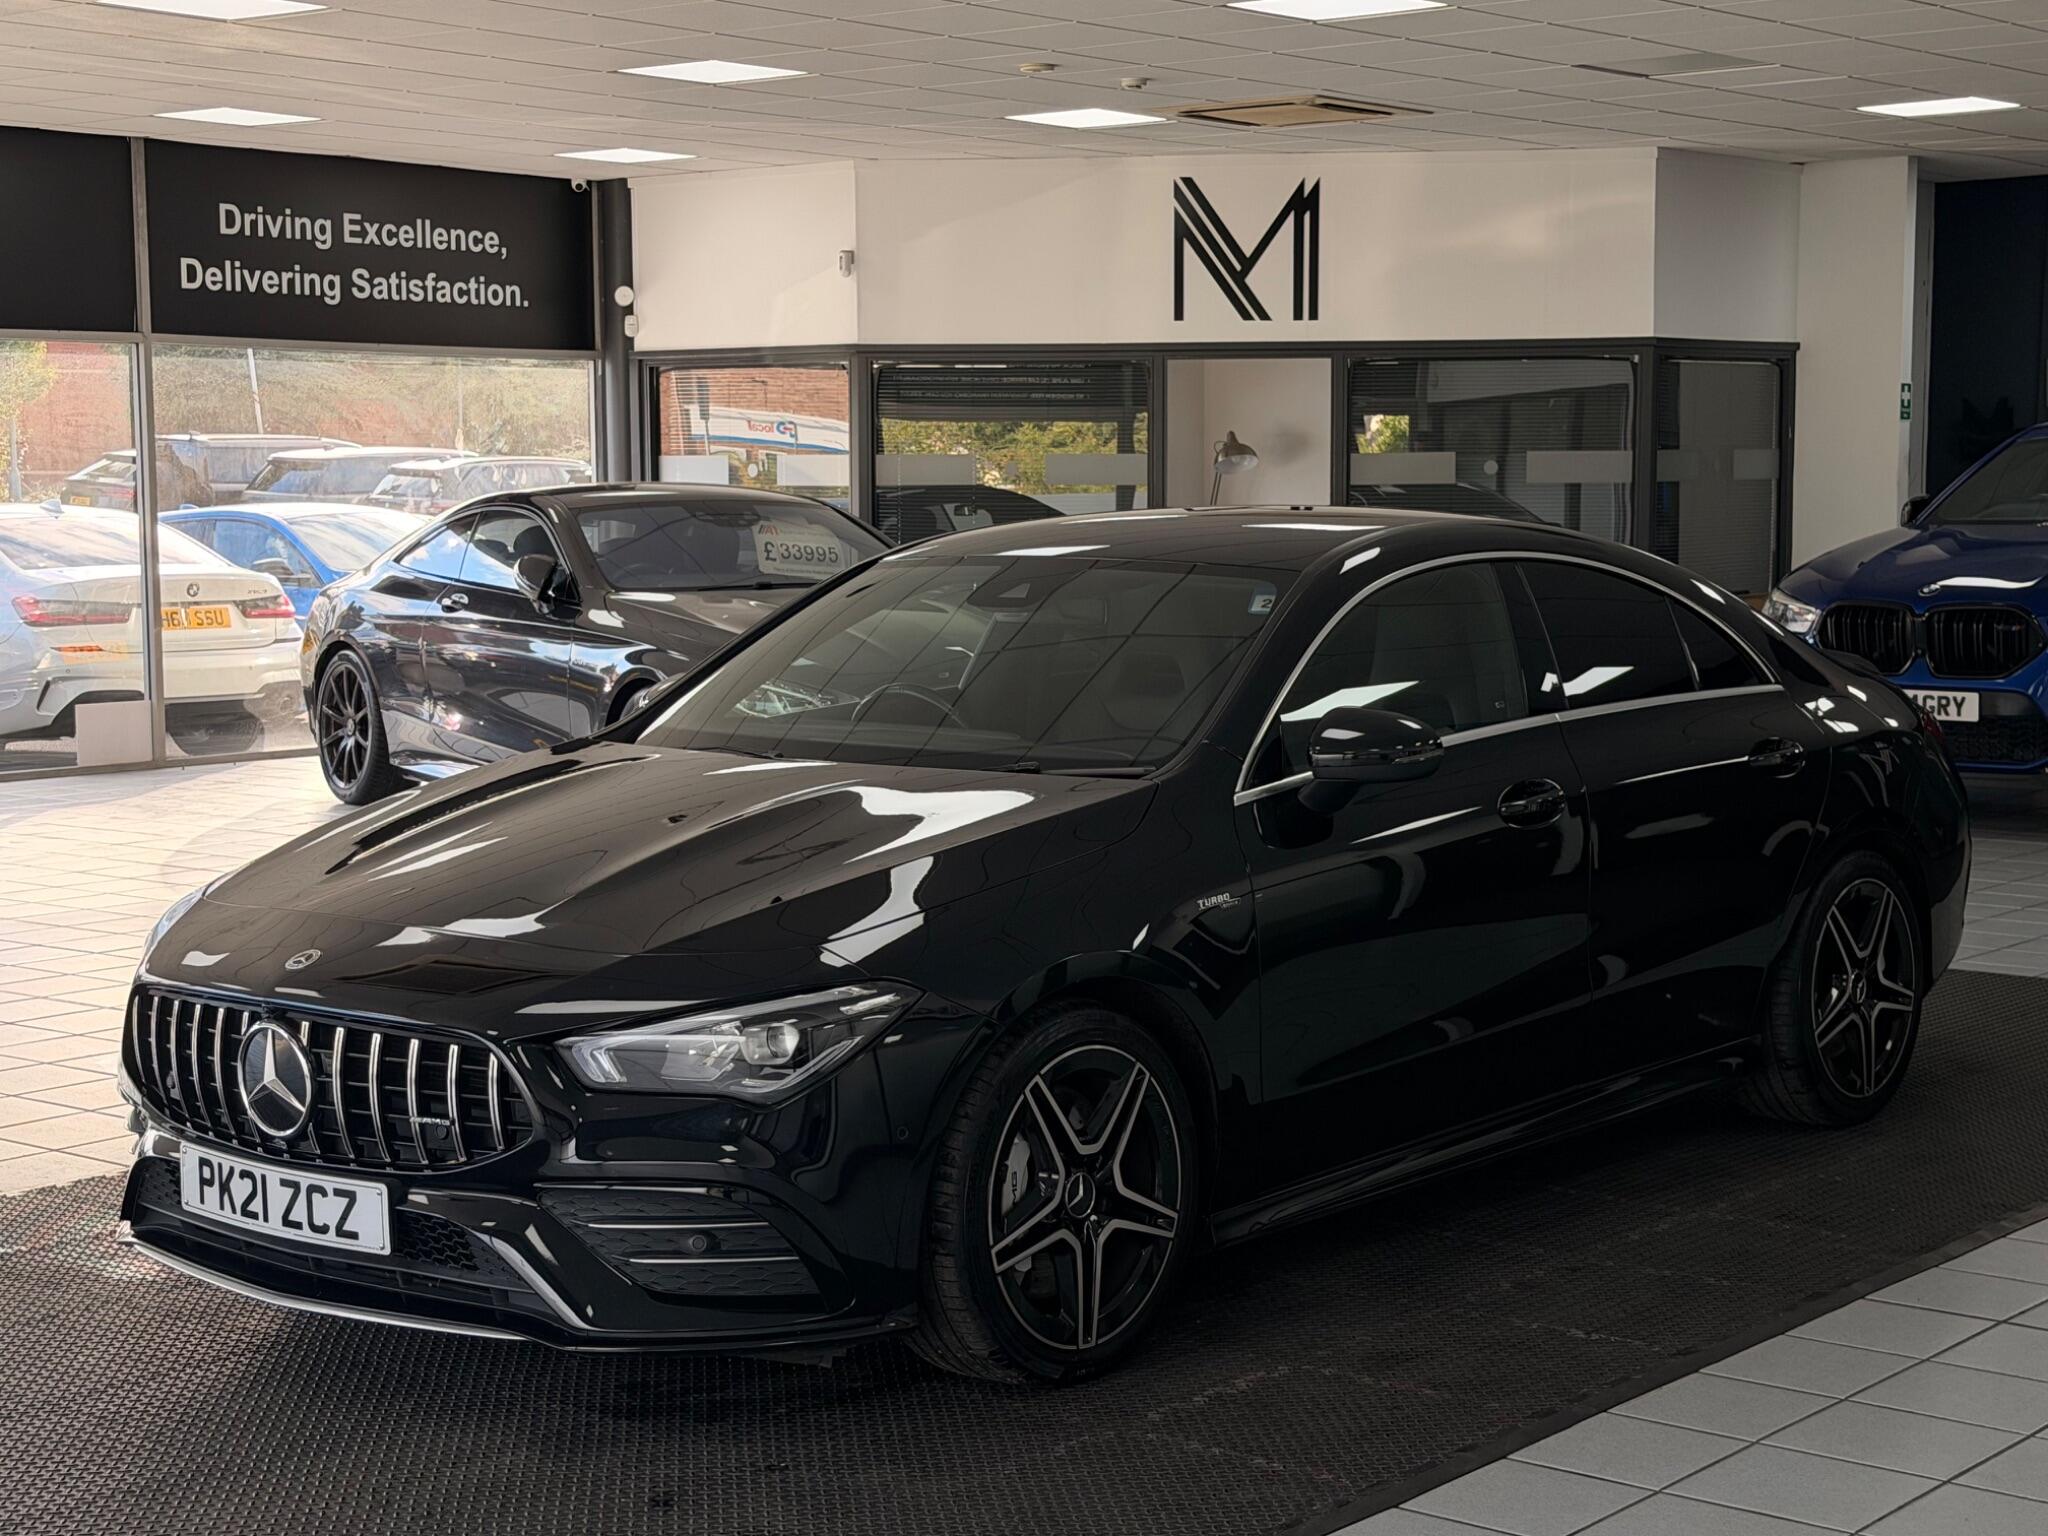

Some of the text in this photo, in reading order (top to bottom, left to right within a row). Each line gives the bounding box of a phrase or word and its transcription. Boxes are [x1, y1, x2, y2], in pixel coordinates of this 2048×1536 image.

[218, 202, 508, 259] Driving Excellence,
[180, 257, 530, 307] Delivering Satisfaction.
[764, 541, 839, 563] £33995
[1196, 892, 1231, 910] TURBO
[198, 1155, 360, 1241] PK21 ZCZ
